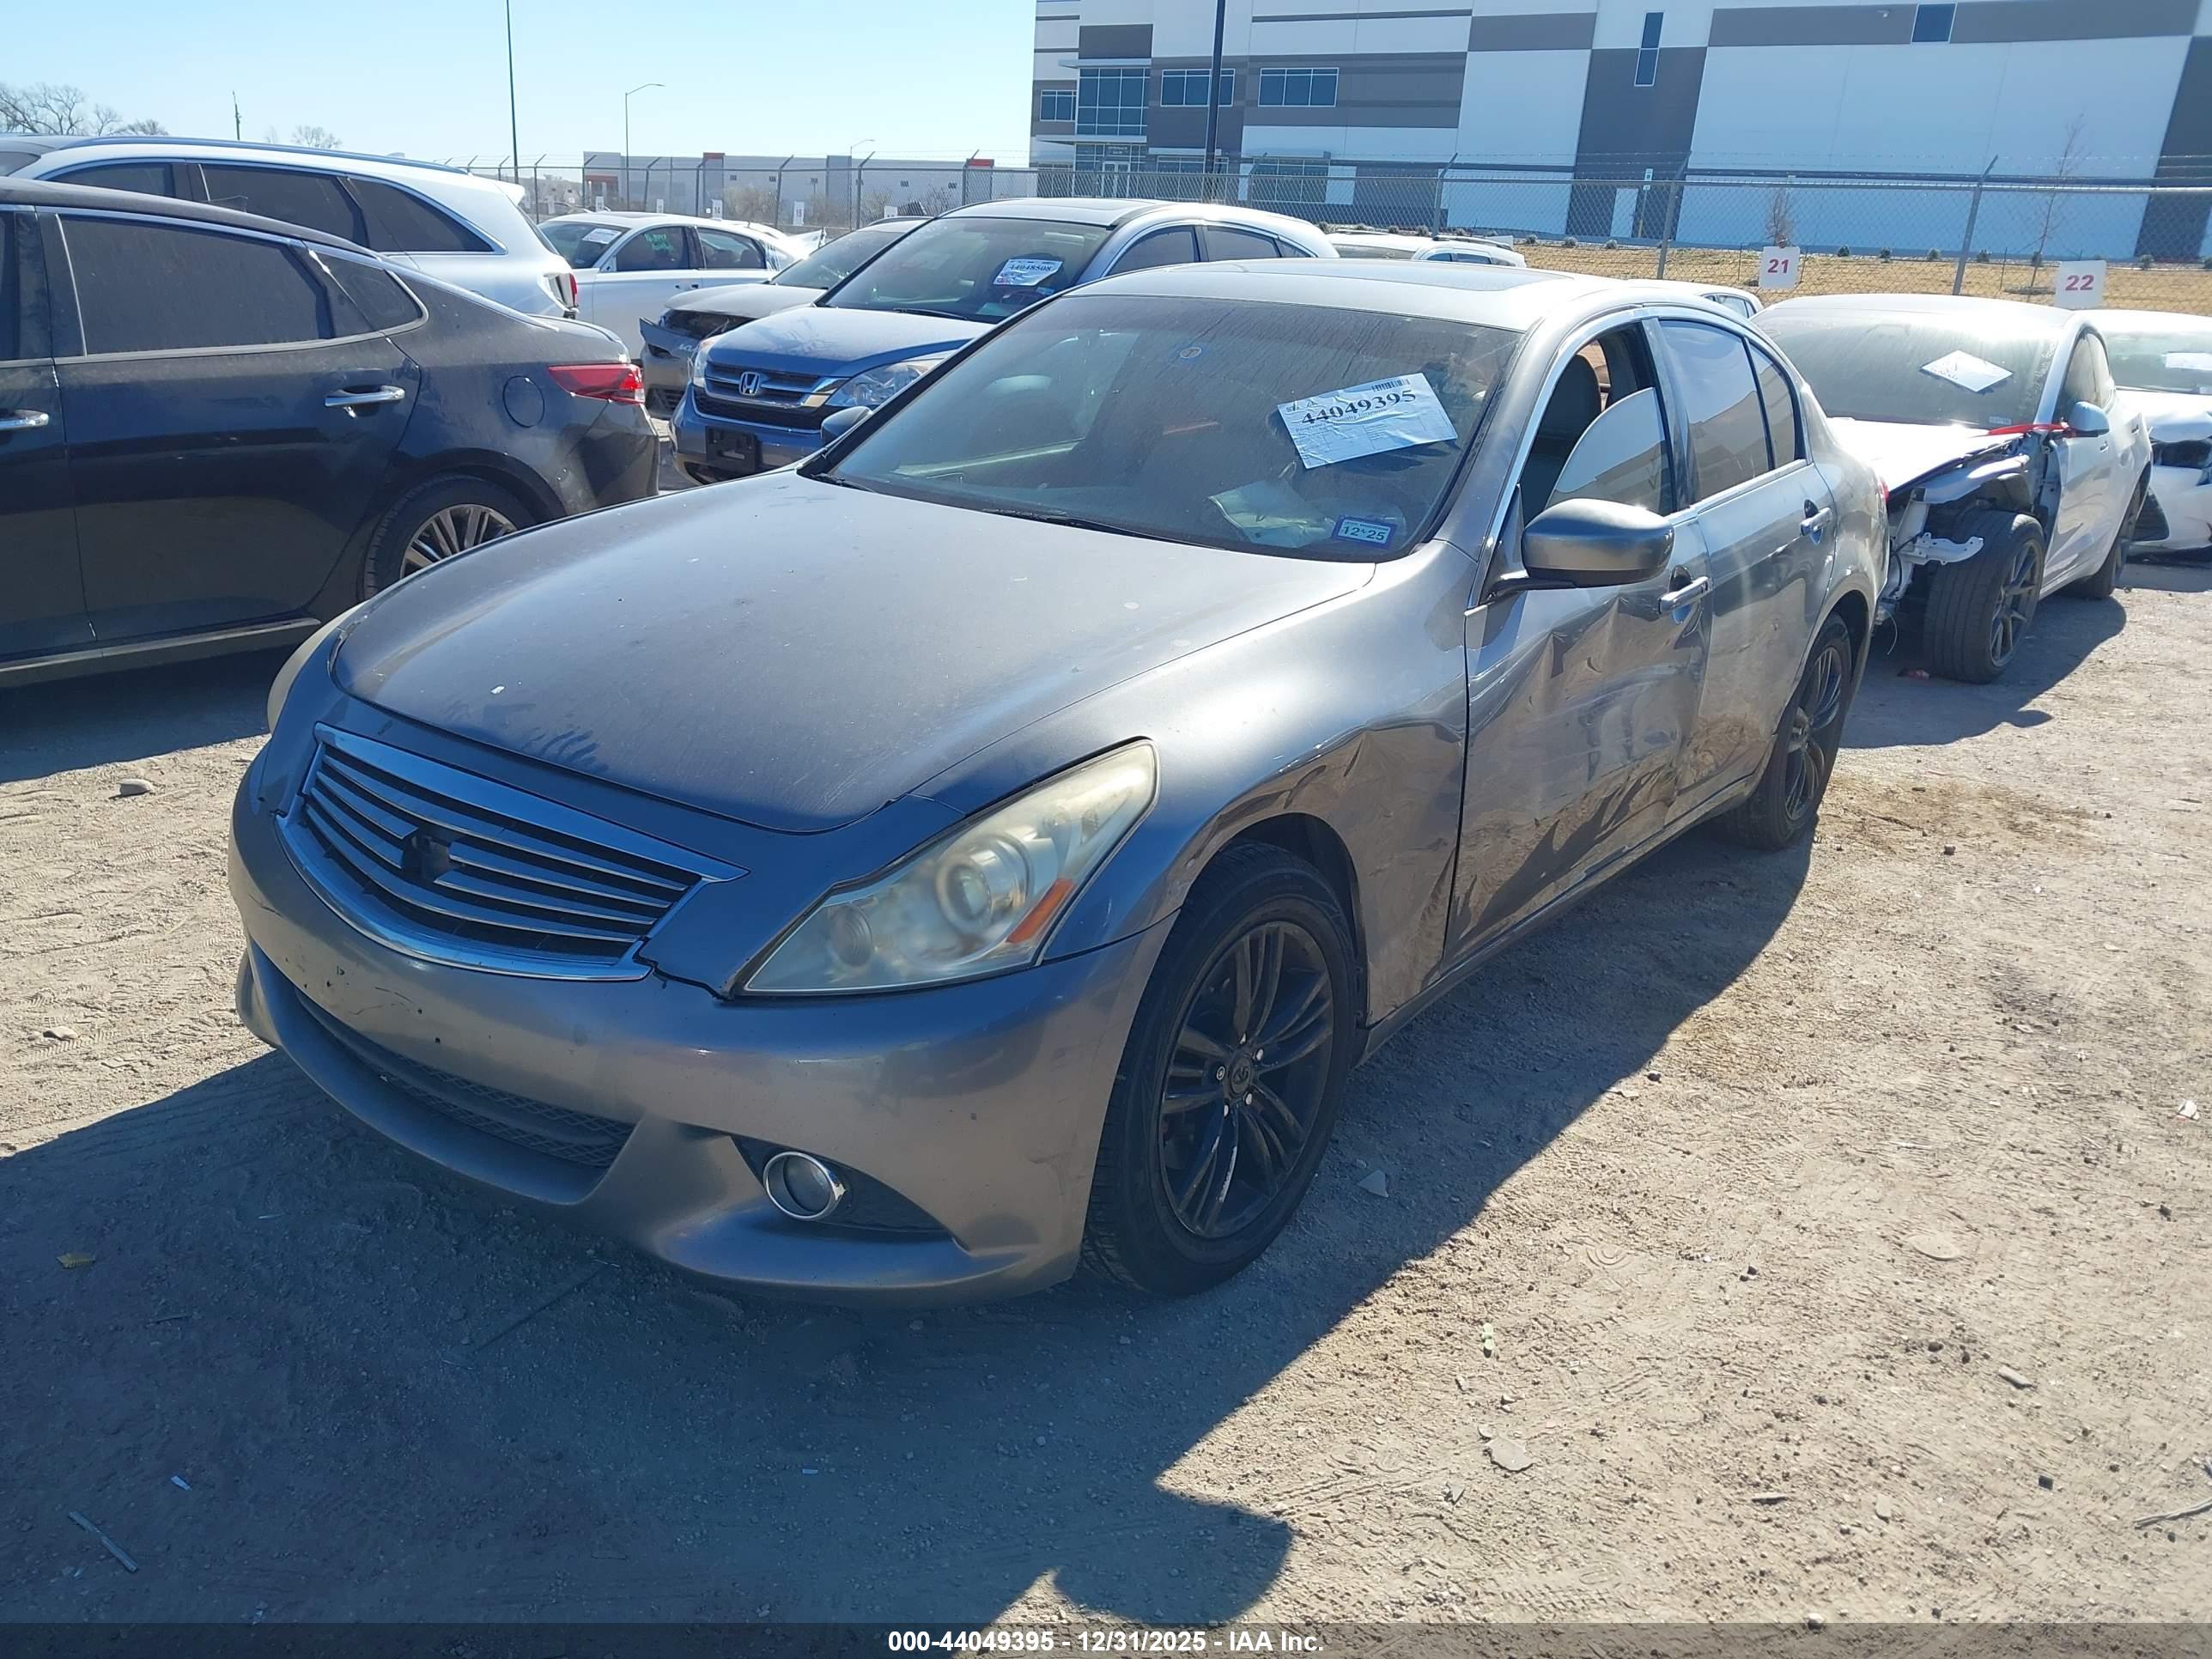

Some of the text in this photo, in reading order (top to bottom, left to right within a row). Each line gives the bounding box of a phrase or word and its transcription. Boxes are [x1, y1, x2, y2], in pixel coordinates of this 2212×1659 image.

[1767, 258, 1790, 274] 21
[2065, 274, 2095, 291] 22
[1302, 390, 1416, 423] 44049395
[1366, 529, 1386, 541] 25
